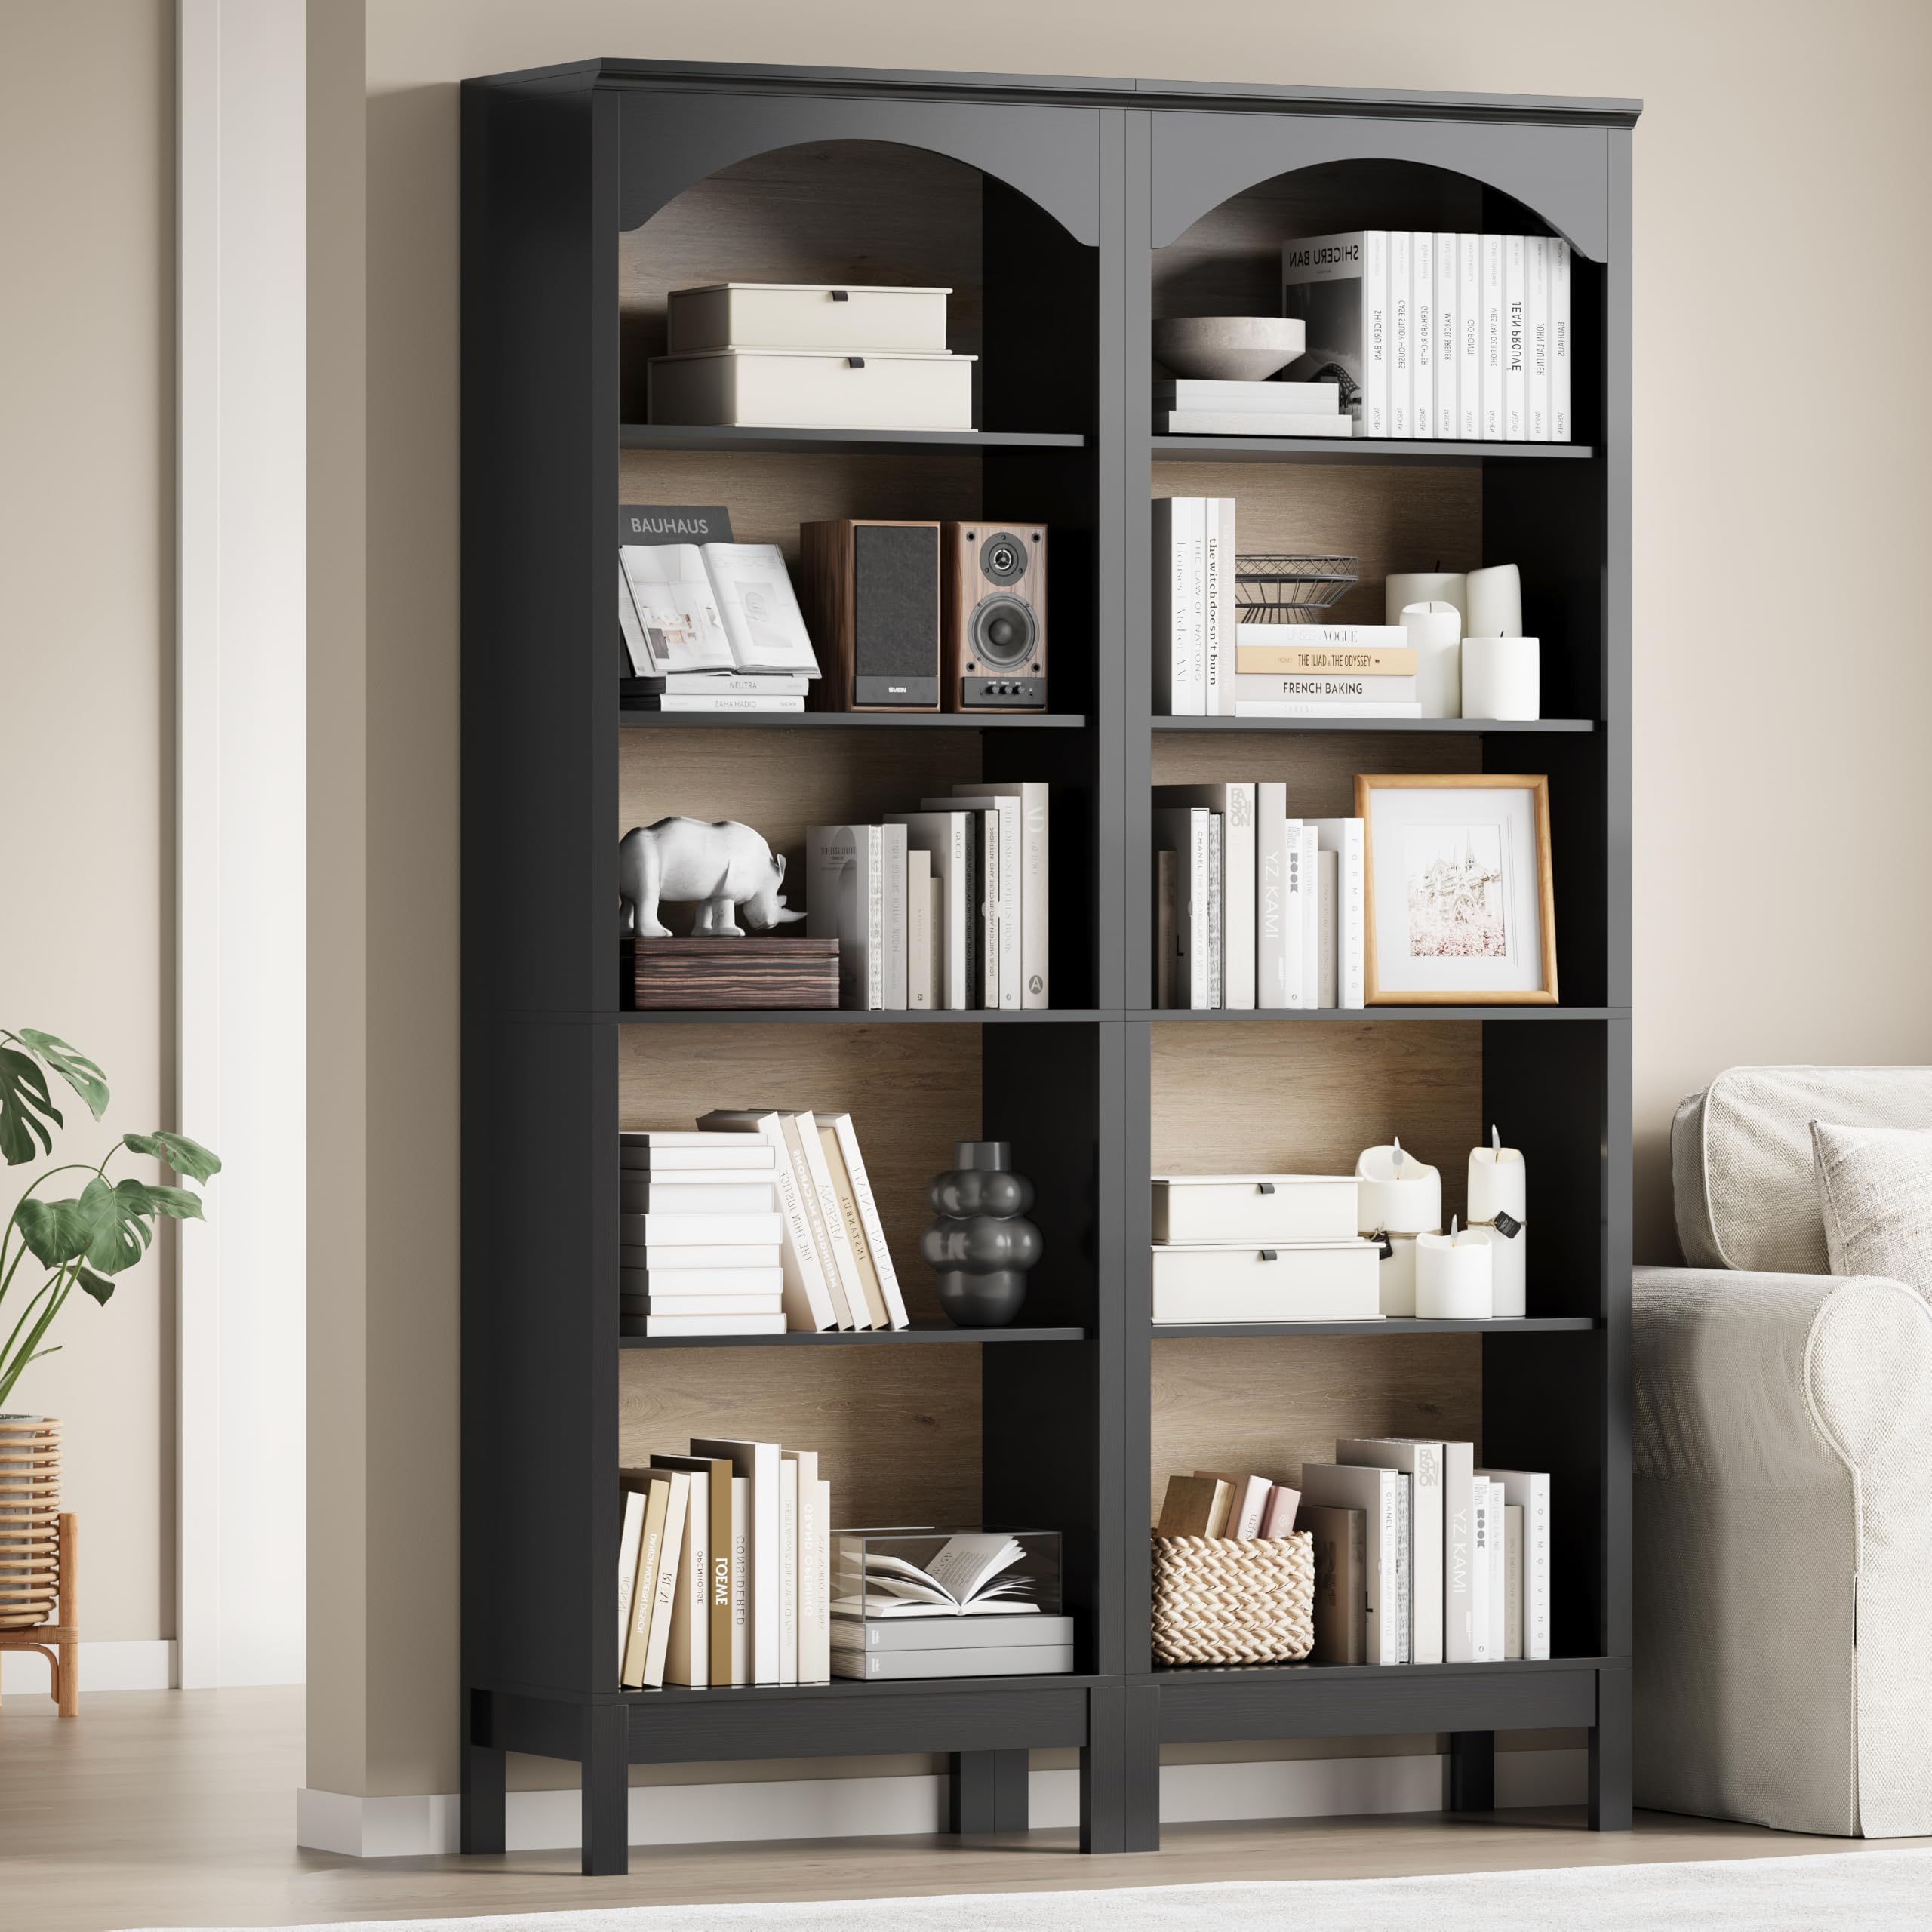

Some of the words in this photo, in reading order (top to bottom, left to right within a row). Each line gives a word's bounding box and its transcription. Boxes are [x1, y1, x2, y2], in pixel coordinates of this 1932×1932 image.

[631, 518, 709, 534] BAUHAUS
[1209, 538, 1218, 560] the
[1209, 560, 1218, 600] witch
[1195, 601, 1201, 617] OF
[1209, 601, 1218, 651] doesn't
[1324, 630, 1358, 642] VOGUE
[1209, 654, 1218, 686] burn
[1298, 654, 1309, 666] THE
[1310, 654, 1327, 666] ILIAD
[1331, 655, 1343, 666] THE
[1345, 655, 1371, 667] ODYSSEY
[1283, 682, 1322, 694] FRENCH
[1325, 682, 1363, 694] BAKING
[1004, 804, 1013, 827] THE
[1004, 830, 1013, 872] DESIGN
[1265, 851, 1279, 881] Y.Z.
[1290, 852, 1298, 894] BOOK
[1004, 875, 1013, 919] HOTELS
[1265, 886, 1279, 939] KAMI
[1004, 924, 1013, 954] BOOK
[1453, 1509, 1466, 1538] Y.Z.
[1476, 1509, 1485, 1549] BOOK
[1453, 1543, 1466, 1593] KAMI
